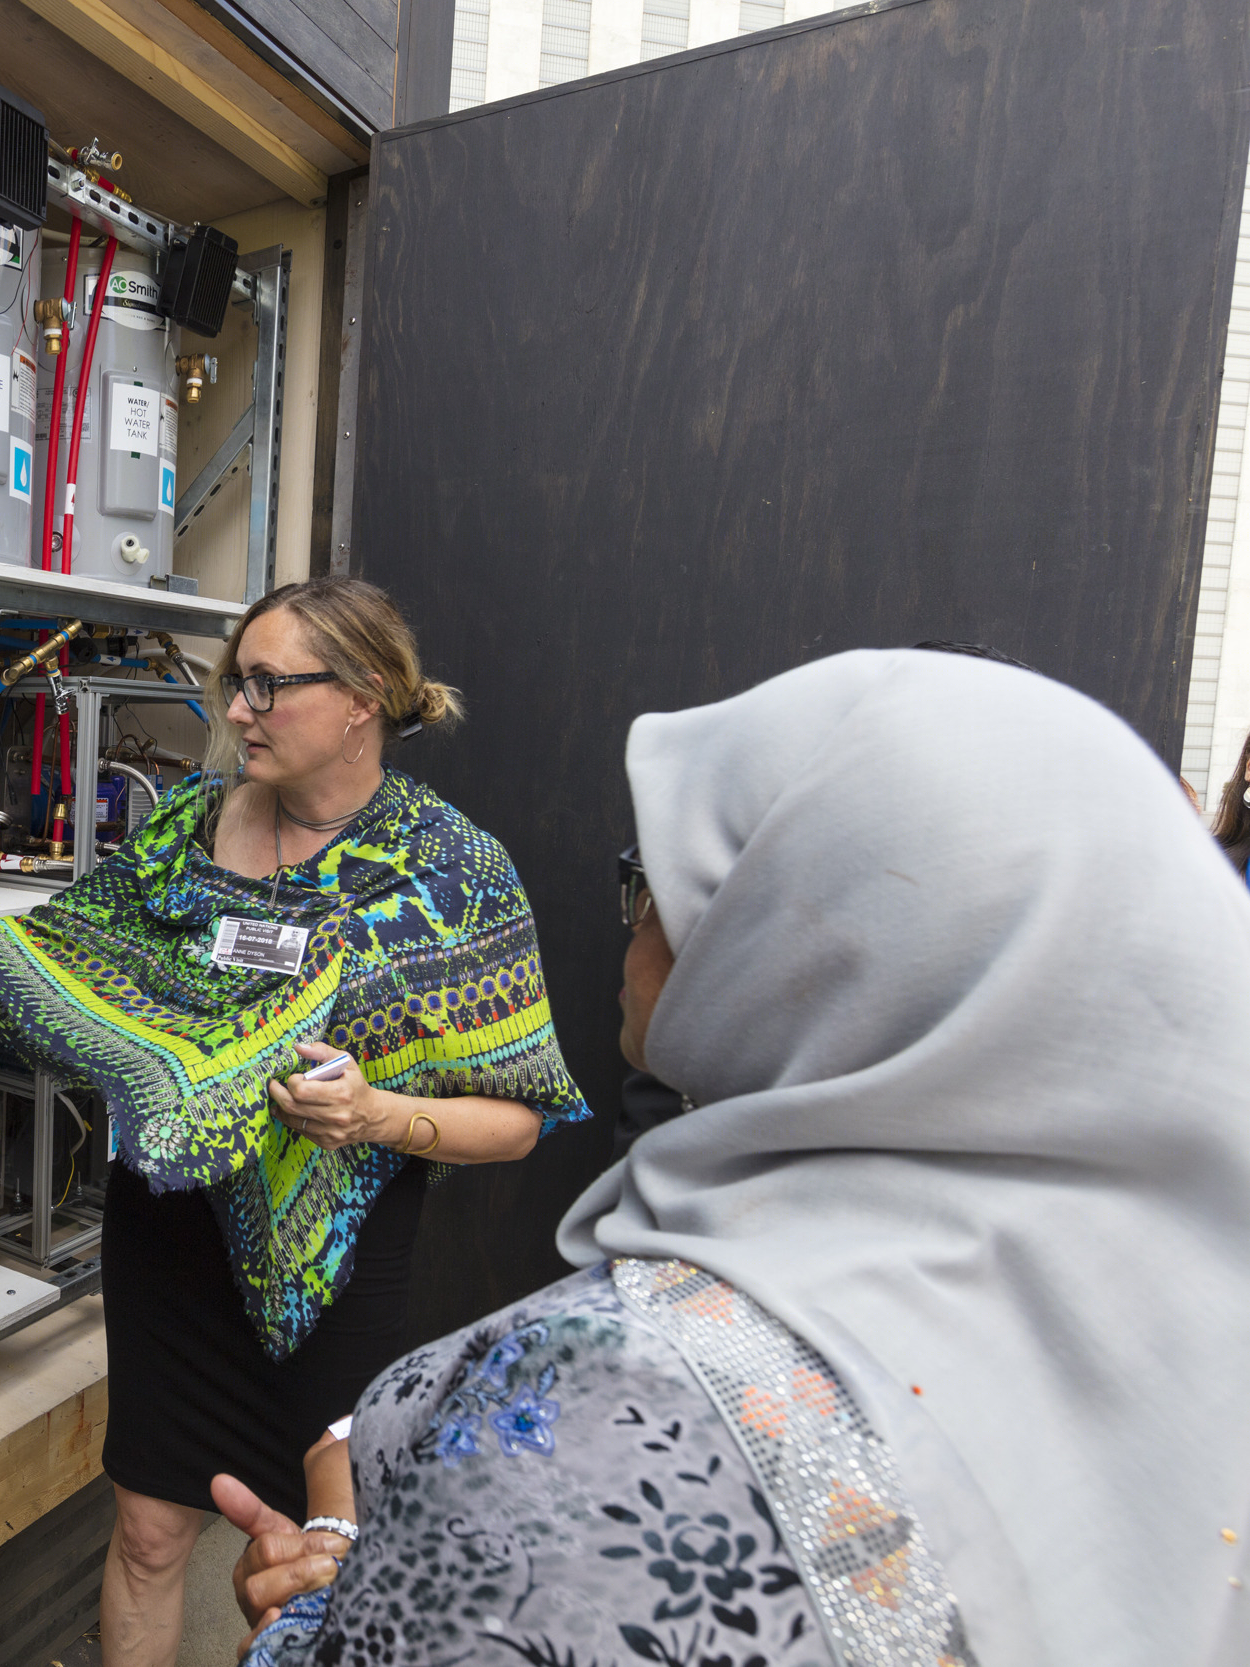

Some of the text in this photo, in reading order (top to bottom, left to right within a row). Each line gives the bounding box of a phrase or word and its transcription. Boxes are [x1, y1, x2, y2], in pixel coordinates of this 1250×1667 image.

[128, 281, 158, 299] Smith
[127, 397, 150, 408] WATER/
[130, 407, 147, 418] HOT
[124, 417, 151, 430] WATER
[127, 428, 147, 440] TANK
